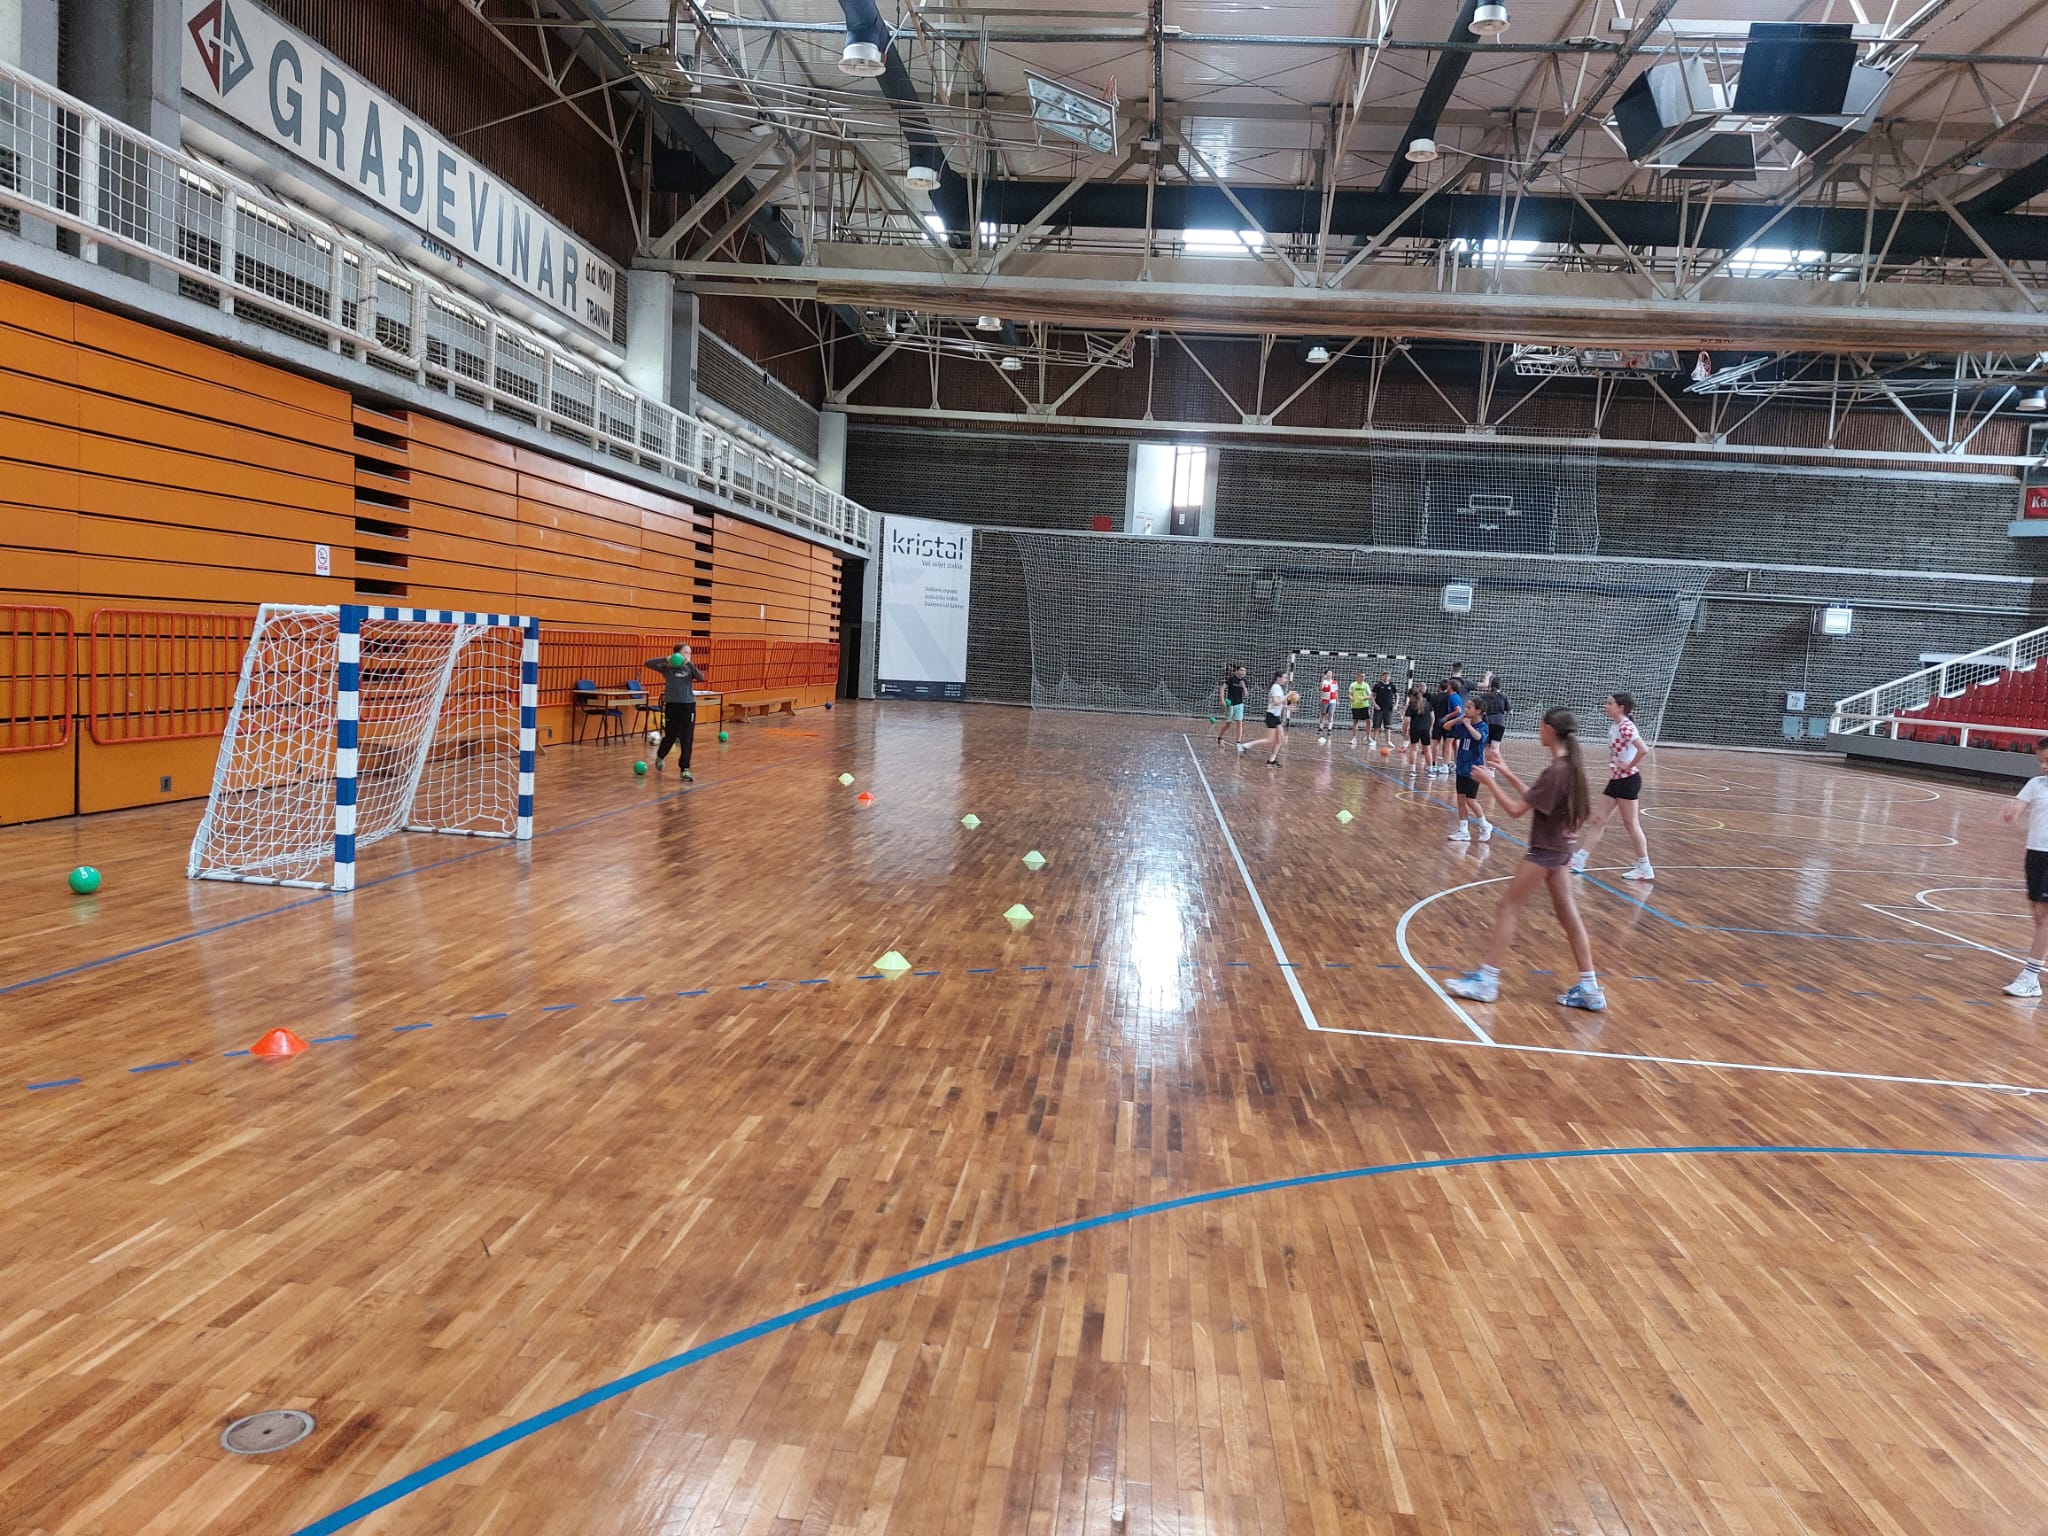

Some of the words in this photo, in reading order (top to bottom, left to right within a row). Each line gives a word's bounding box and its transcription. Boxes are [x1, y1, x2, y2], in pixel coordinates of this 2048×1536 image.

[268, 39, 579, 313] GRAĐEVINAR
[421, 235, 452, 261] ZAPAD
[892, 528, 963, 560] kristal
